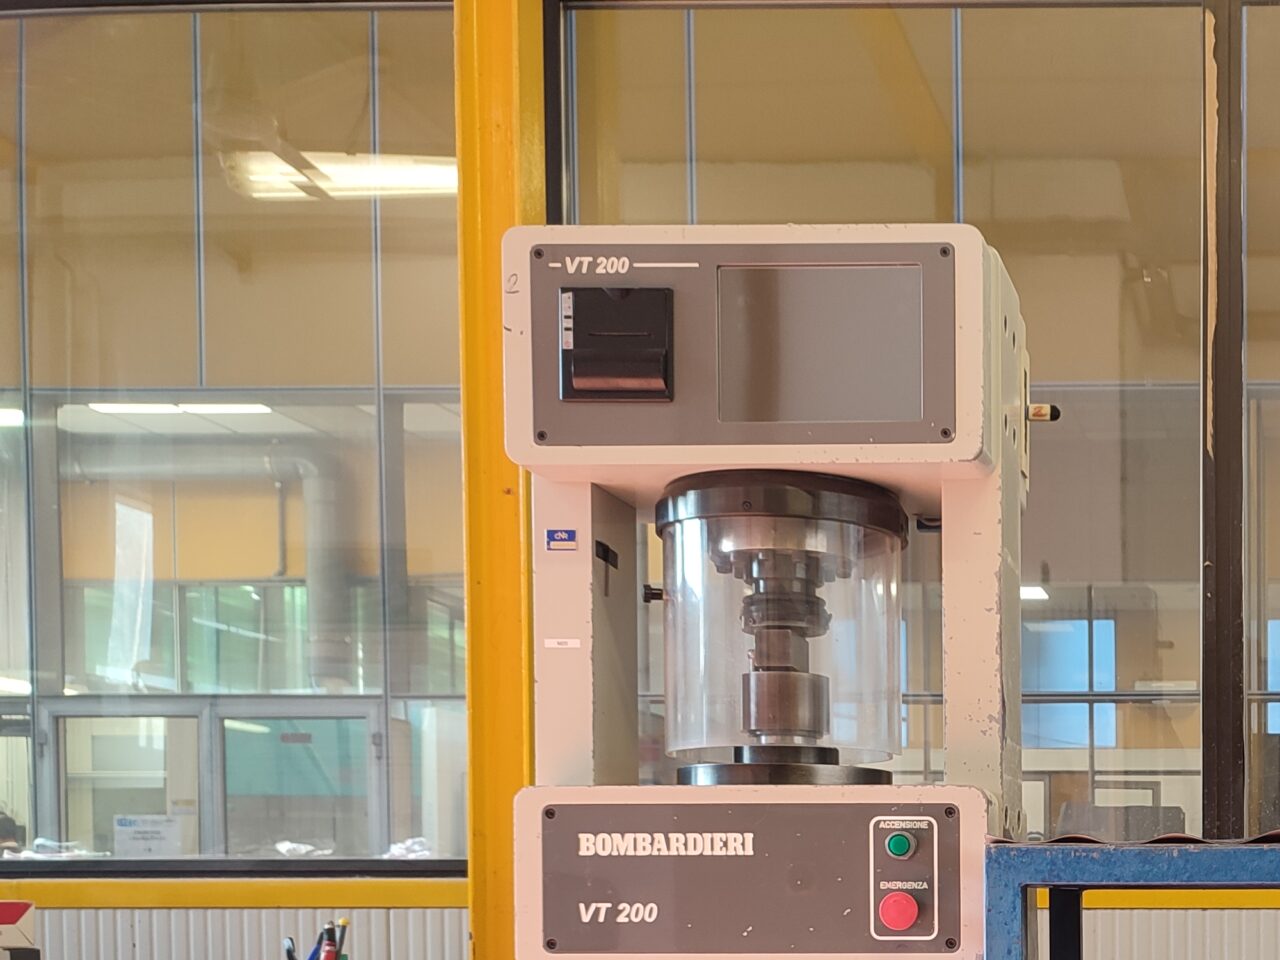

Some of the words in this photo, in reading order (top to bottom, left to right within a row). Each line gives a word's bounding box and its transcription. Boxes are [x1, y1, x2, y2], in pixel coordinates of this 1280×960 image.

[565, 256, 594, 275] VT
[595, 256, 630, 275] 200
[879, 821, 929, 829] ACCENSIONE
[578, 832, 754, 856] BOMBARDIERI
[879, 881, 928, 890] EMERGENZA
[578, 902, 612, 923] VT
[616, 902, 658, 923] 200
